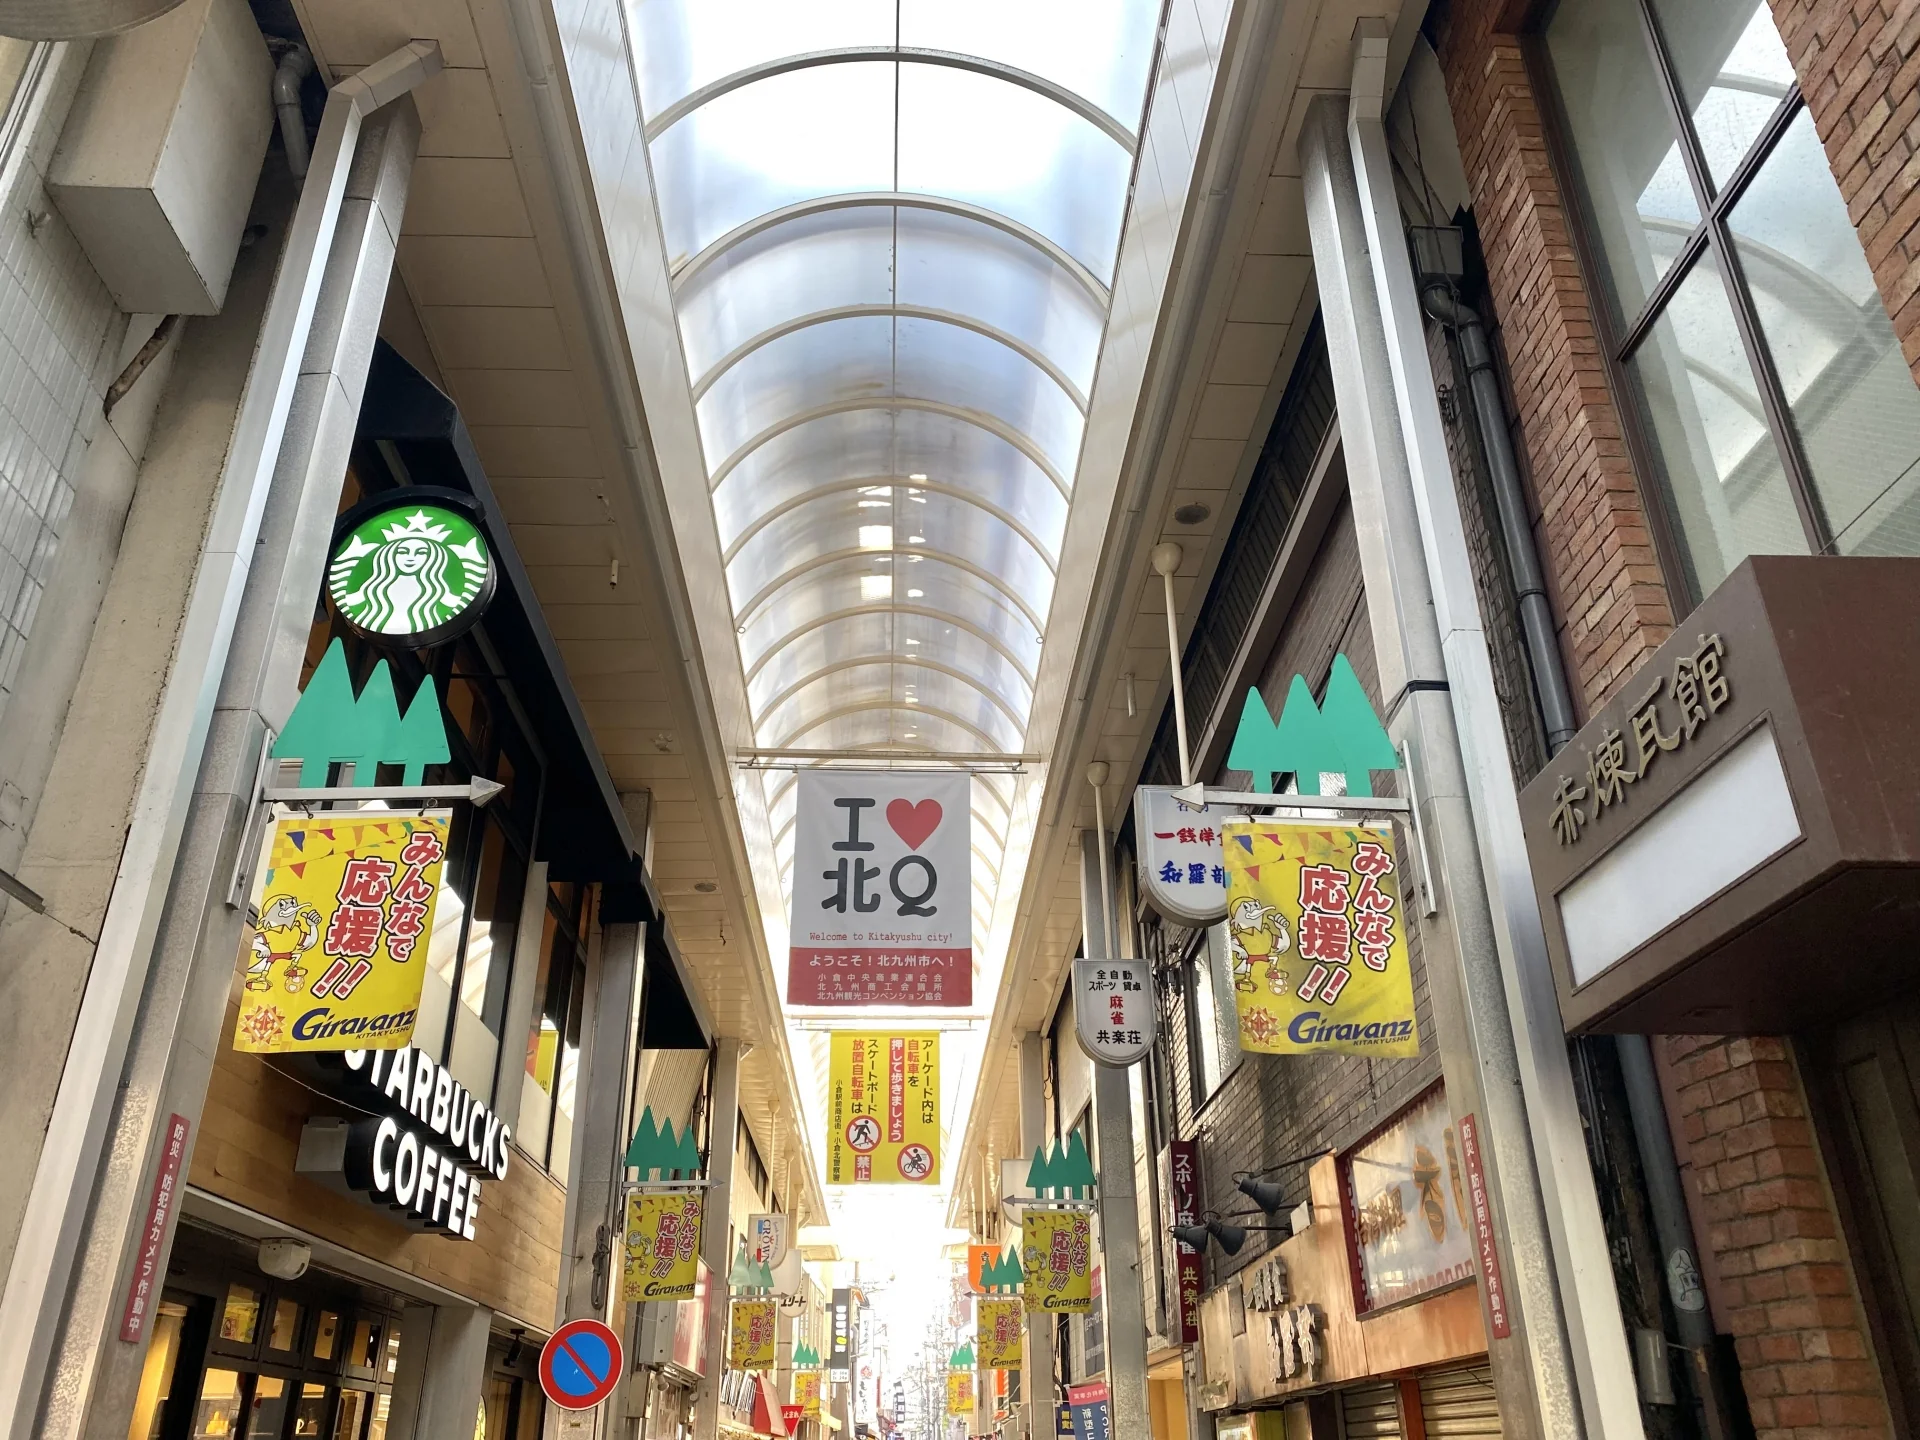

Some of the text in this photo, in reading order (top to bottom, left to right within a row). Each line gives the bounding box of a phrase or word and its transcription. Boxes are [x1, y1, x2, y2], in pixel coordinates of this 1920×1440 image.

[1548, 633, 1729, 845] 赤煉瓦館
[832, 798, 876, 851] I
[386, 832, 443, 962] みんなで
[821, 855, 937, 917] 北Q
[1352, 843, 1396, 972] みんなで
[810, 932, 953, 943] Welcome to Kitakyushu city!
[817, 982, 943, 991] 北九州商工会議所
[1088, 981, 1116, 991] スポーツ
[1097, 969, 1133, 980] 全自動
[817, 991, 943, 1001] 北九州観光コンベンション協会
[1110, 995, 1124, 1025] 麻雀
[292, 1007, 417, 1041] Giravanz
[355, 1023, 412, 1040] KITAKYUSHU
[1096, 1029, 1142, 1045] 共楽荘
[1288, 1011, 1414, 1044] Giravanz
[1353, 1035, 1411, 1046] KITAKYUSHU
[851, 1039, 864, 1114] 放置自転車は
[866, 1039, 878, 1115] スケートボード
[907, 1039, 919, 1087] 自転車を
[891, 1039, 902, 1141] 押して歩きましょう
[922, 1039, 933, 1124] アーケード内は
[373, 1116, 482, 1241] COFFEE
[856, 1155, 870, 1181] 禁止
[678, 1201, 699, 1261] みんなで
[1072, 1219, 1090, 1277] みんなで
[644, 1282, 696, 1296] Giravanz
[1043, 1294, 1091, 1309] Giravanz
[1182, 1266, 1198, 1327] 共楽荘
[783, 1411, 799, 1419] 止まれ
